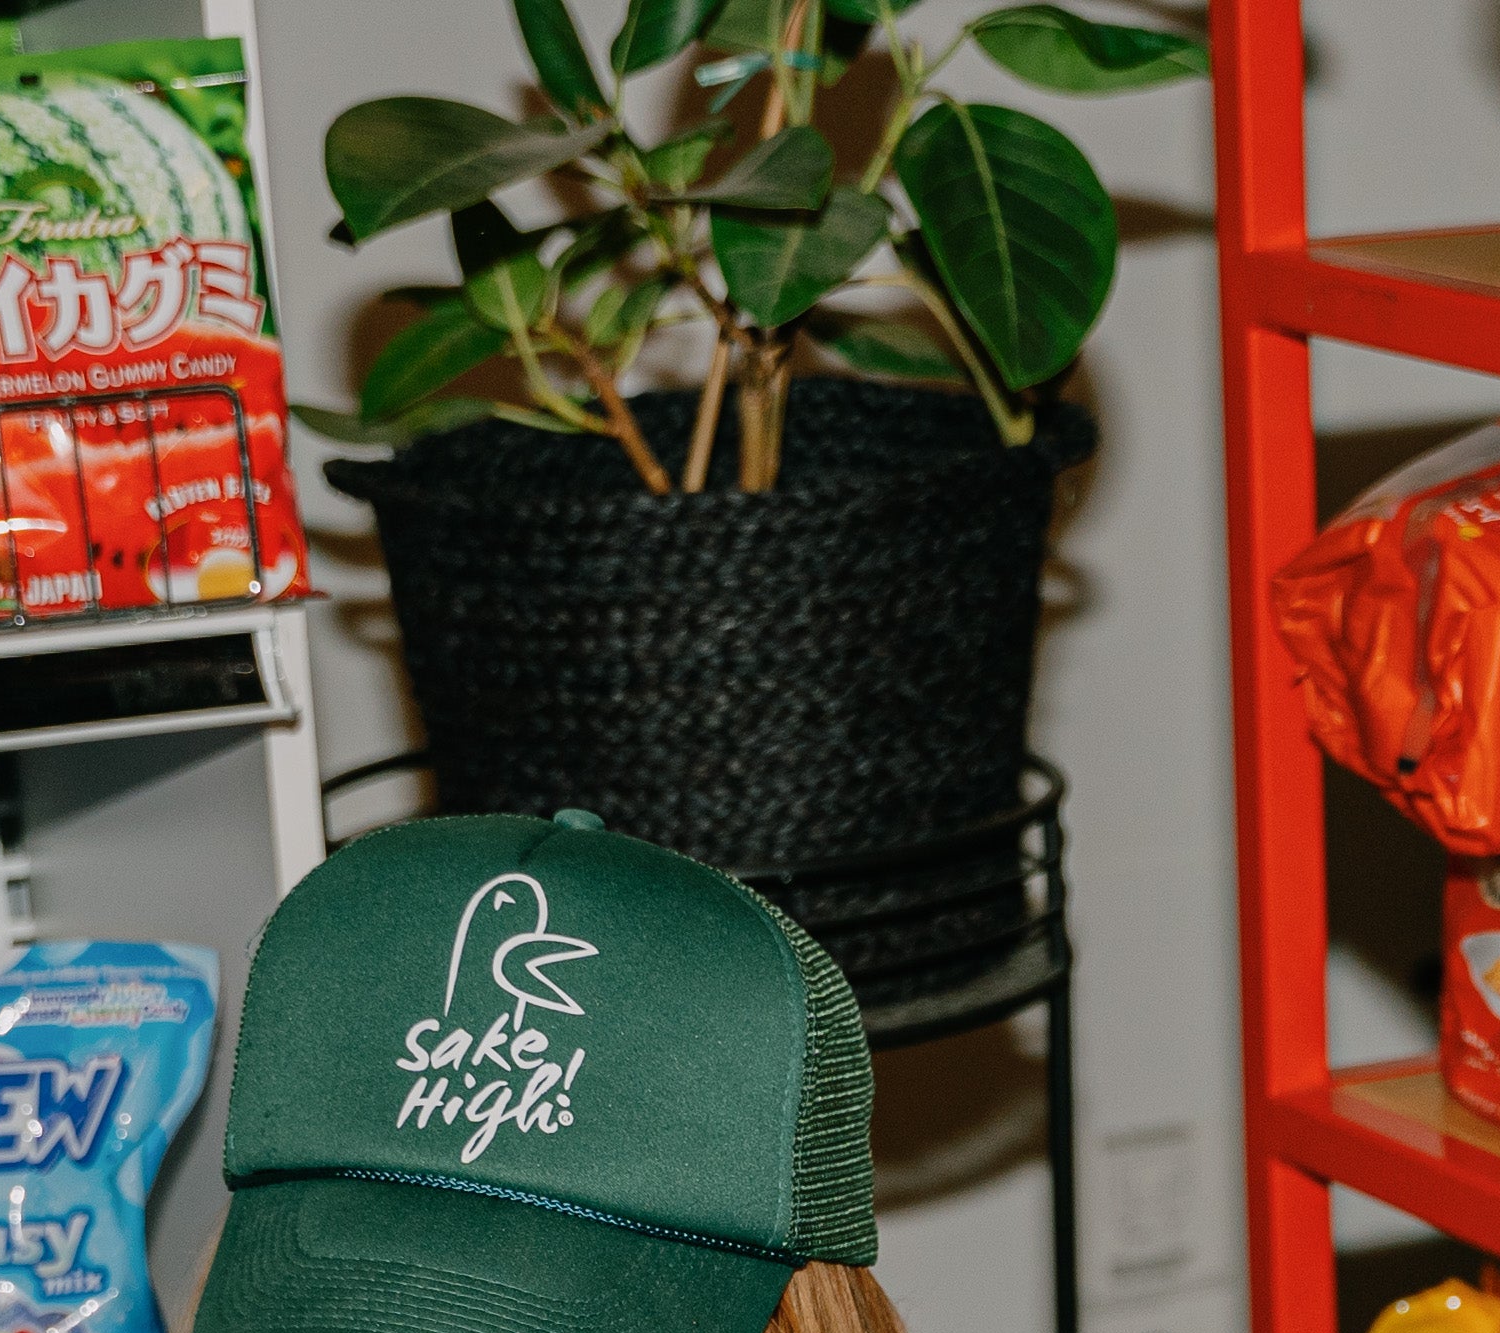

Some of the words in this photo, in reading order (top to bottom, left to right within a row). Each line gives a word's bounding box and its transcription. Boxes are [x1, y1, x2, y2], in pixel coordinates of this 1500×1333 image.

[87, 359, 169, 391] GUMMY
[170, 350, 238, 380] CANDY
[396, 1010, 551, 1076] Sake
[396, 1047, 586, 1164] High!
[43, 1271, 103, 1296] mix
